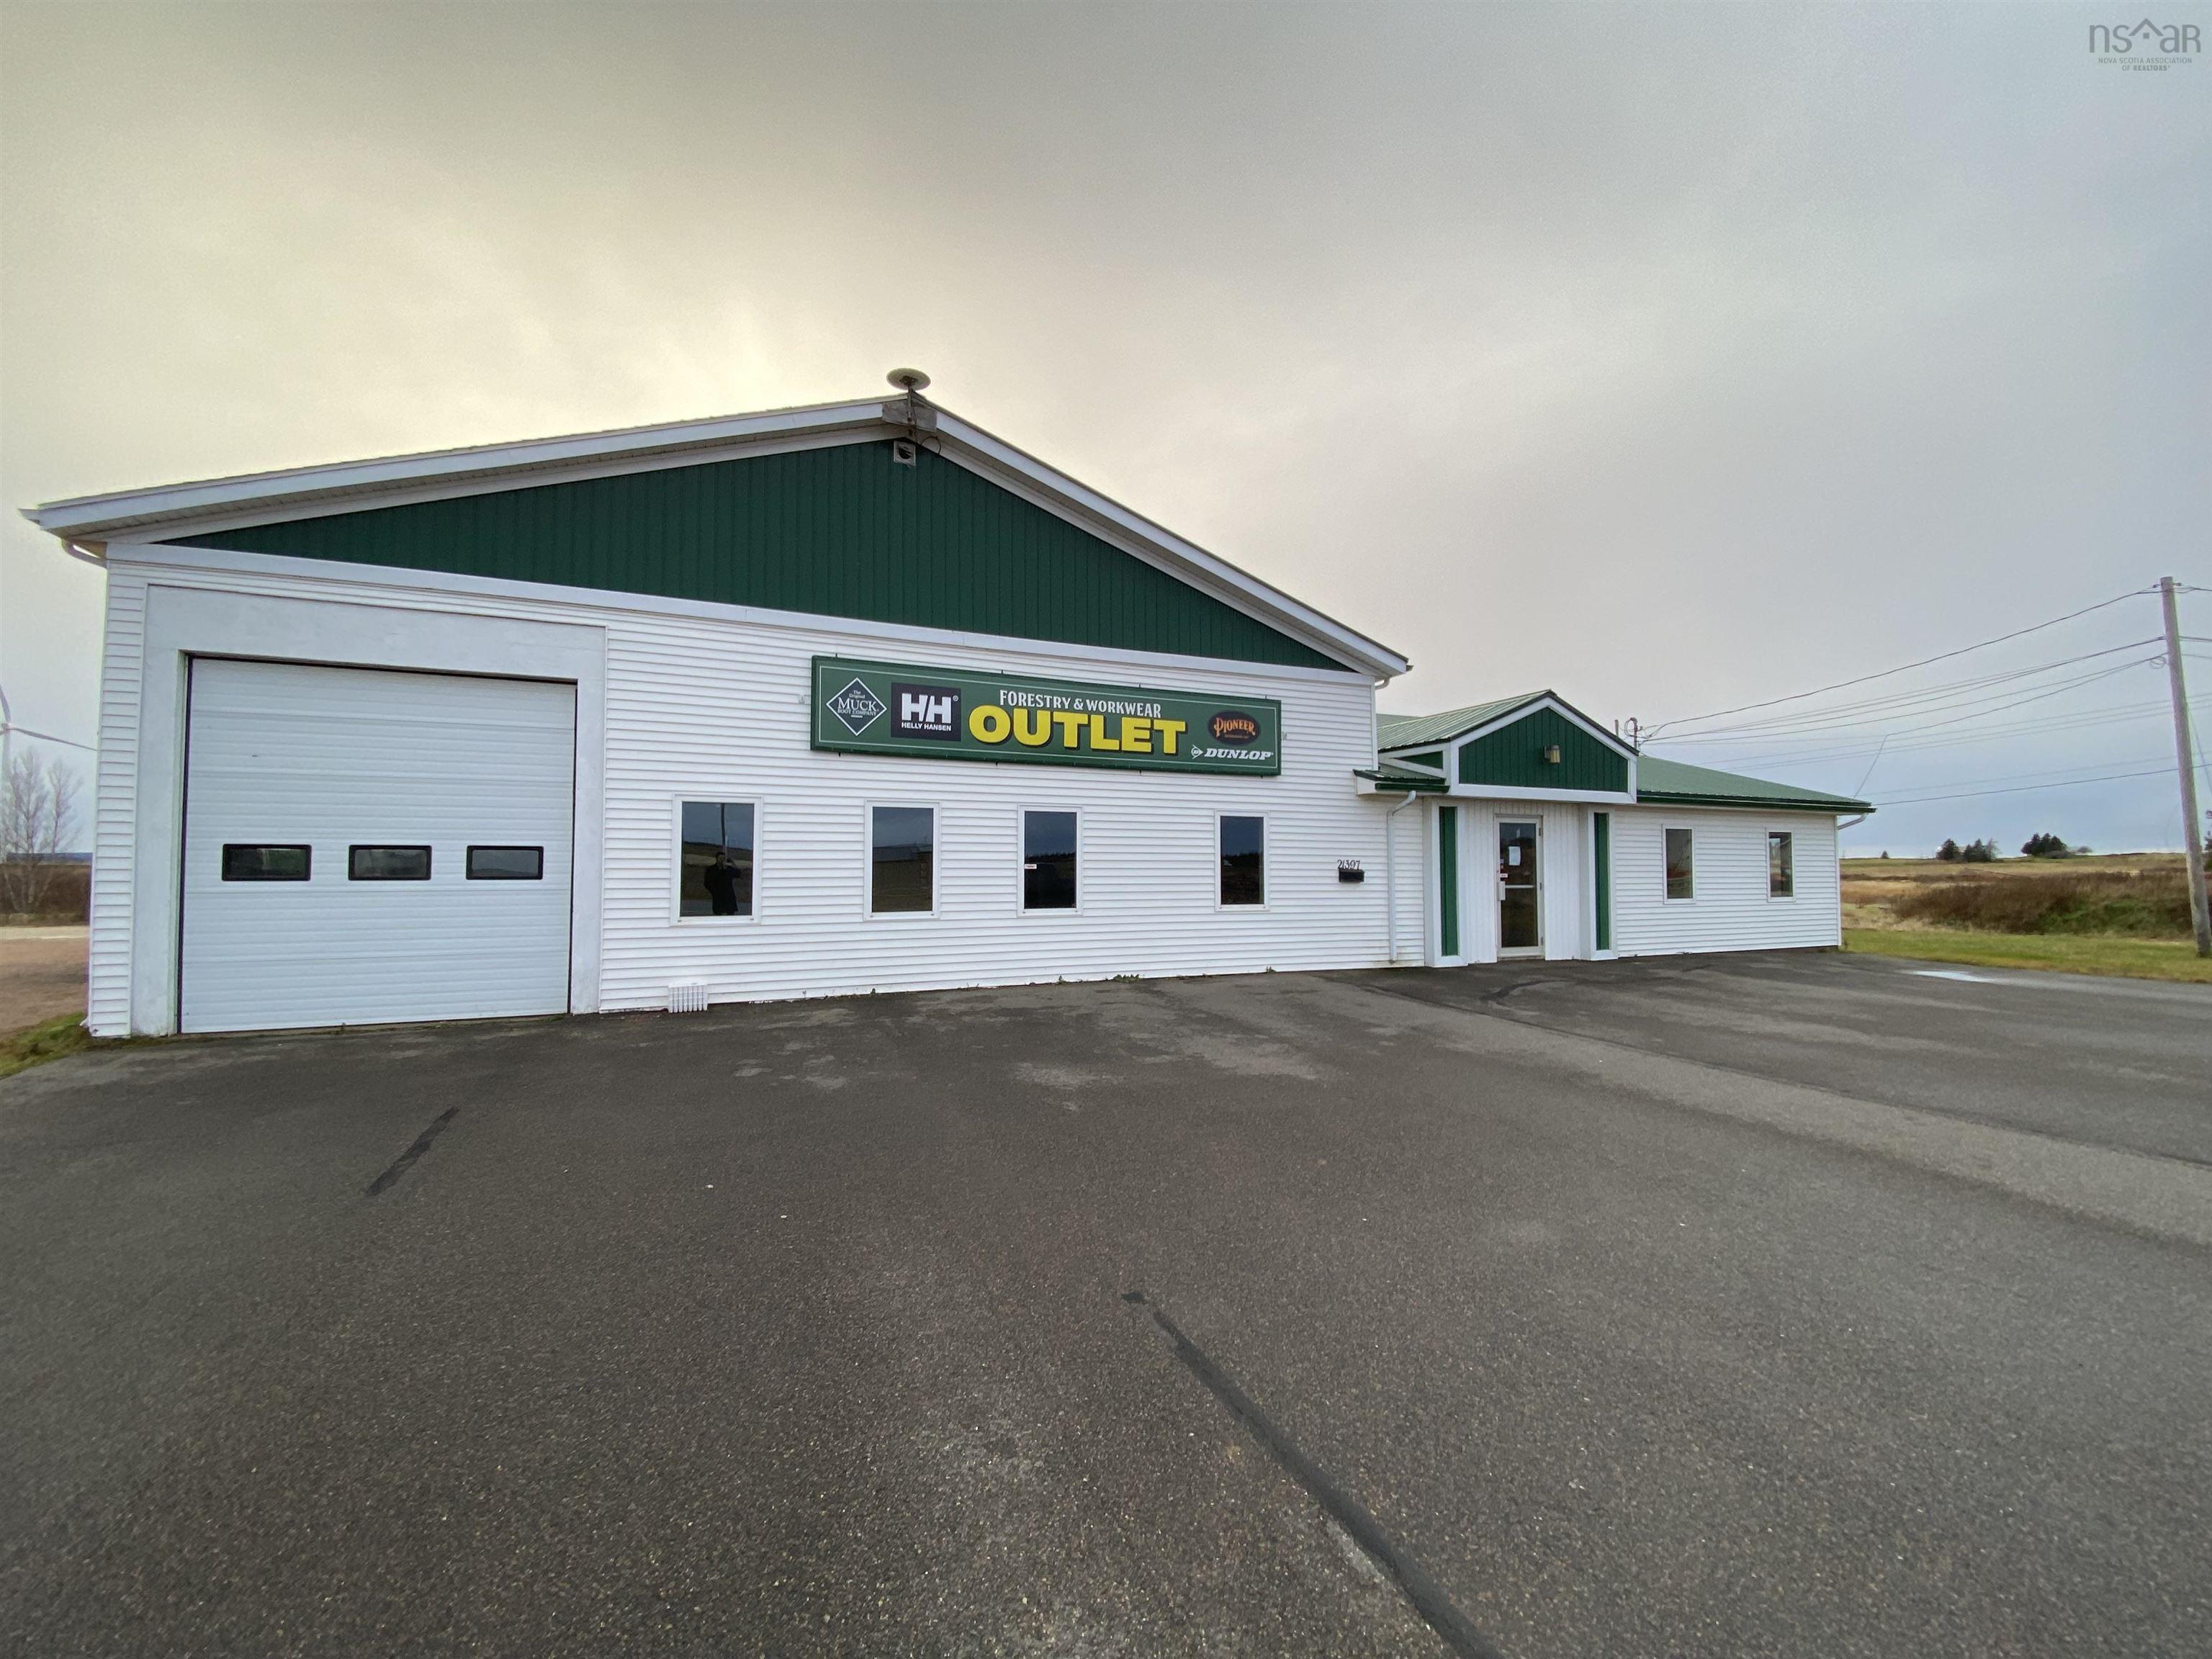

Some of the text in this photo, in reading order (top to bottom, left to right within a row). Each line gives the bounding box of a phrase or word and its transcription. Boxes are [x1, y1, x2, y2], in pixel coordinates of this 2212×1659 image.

[837, 696, 877, 711] MUCK
[999, 689, 1161, 719] FORESTRY & WORKWEAR
[924, 723, 952, 732] HANSEN
[968, 705, 1187, 754] OUTLET
[1204, 748, 1272, 760] DUNLOP
[1337, 859, 1360, 870] 21397
